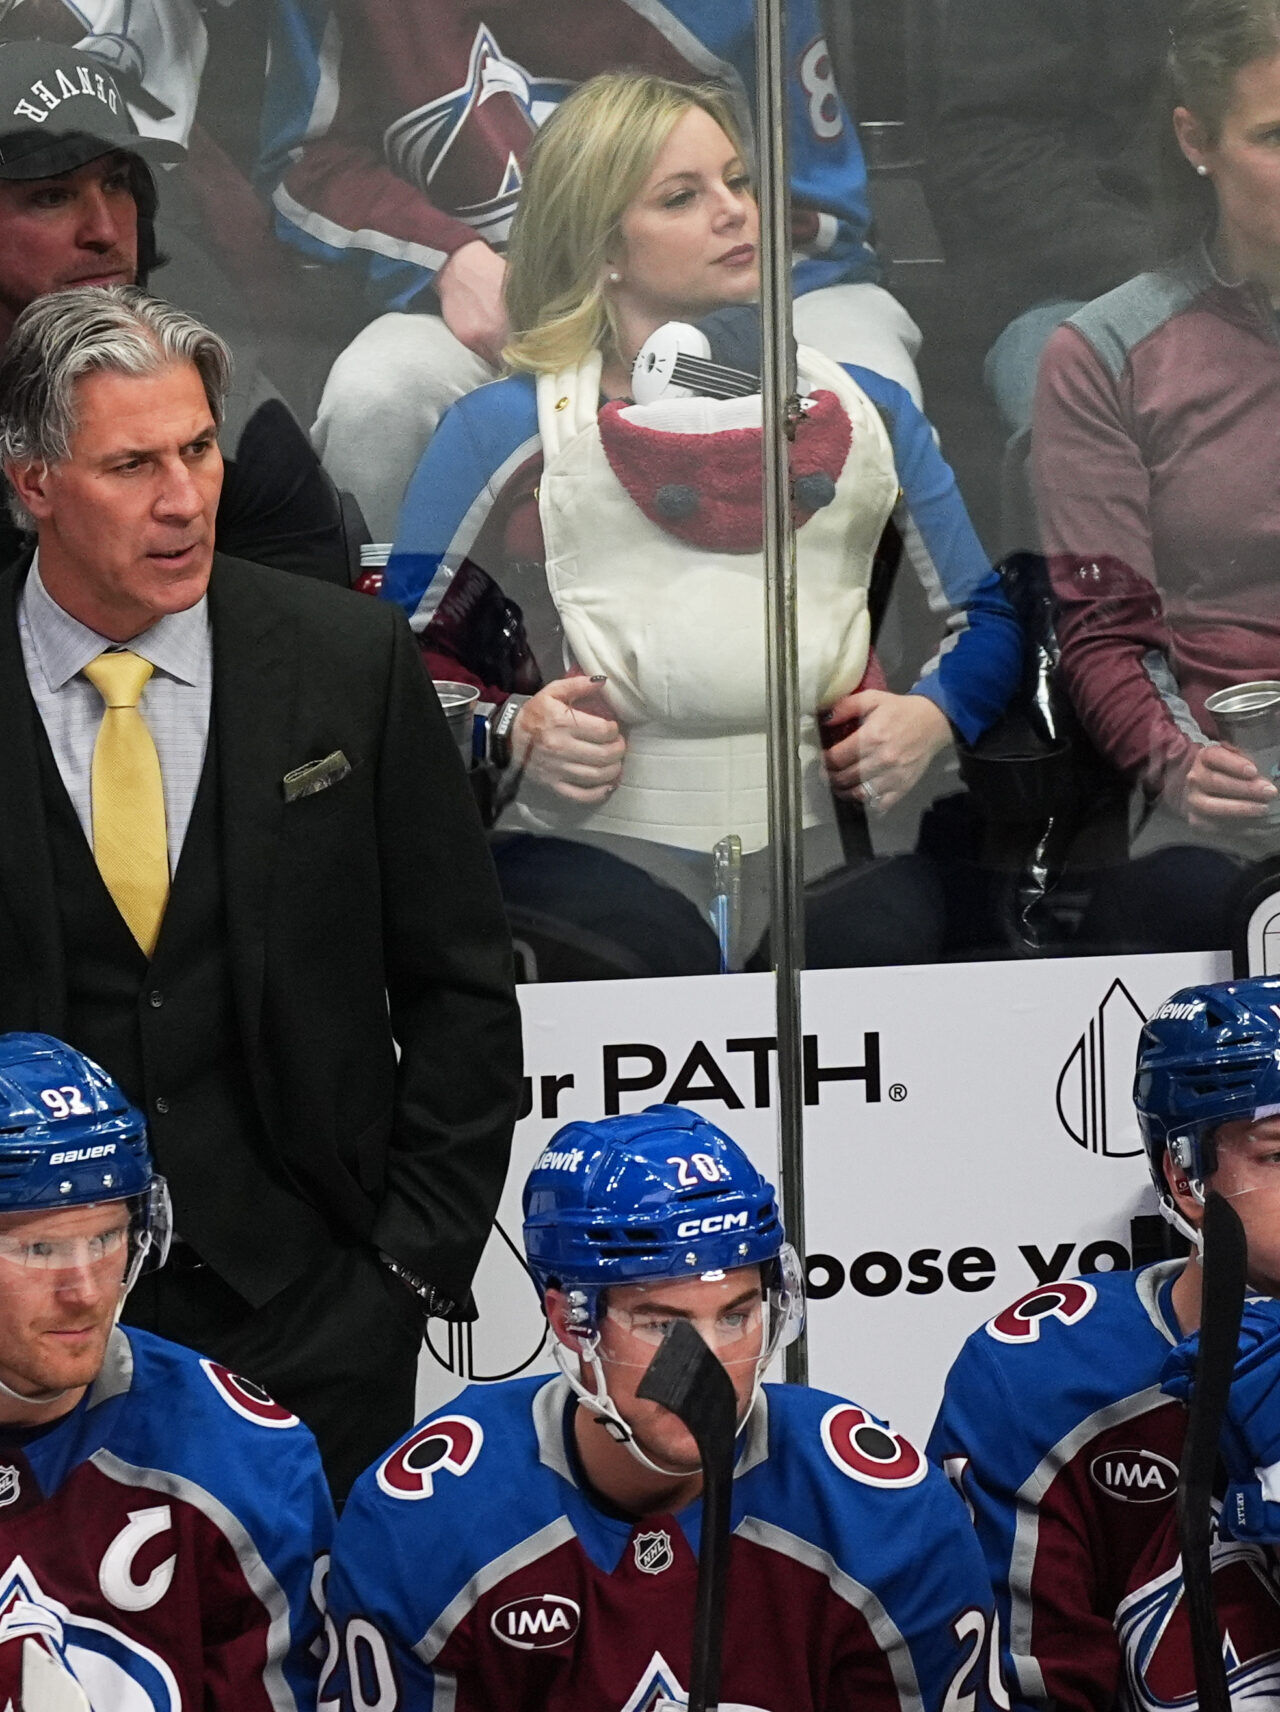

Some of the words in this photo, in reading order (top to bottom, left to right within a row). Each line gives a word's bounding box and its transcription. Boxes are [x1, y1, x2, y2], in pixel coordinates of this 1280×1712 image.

[13, 66, 118, 123] DENVER
[40, 1086, 92, 1119] 92
[49, 1143, 116, 1165] BAUER
[666, 1152, 723, 1187] 20
[677, 1211, 748, 1239] CCM
[1105, 1461, 1167, 1490] IMA
[98, 1504, 177, 1612] C
[642, 1541, 666, 1567] NHL
[508, 1607, 571, 1636] IMA
